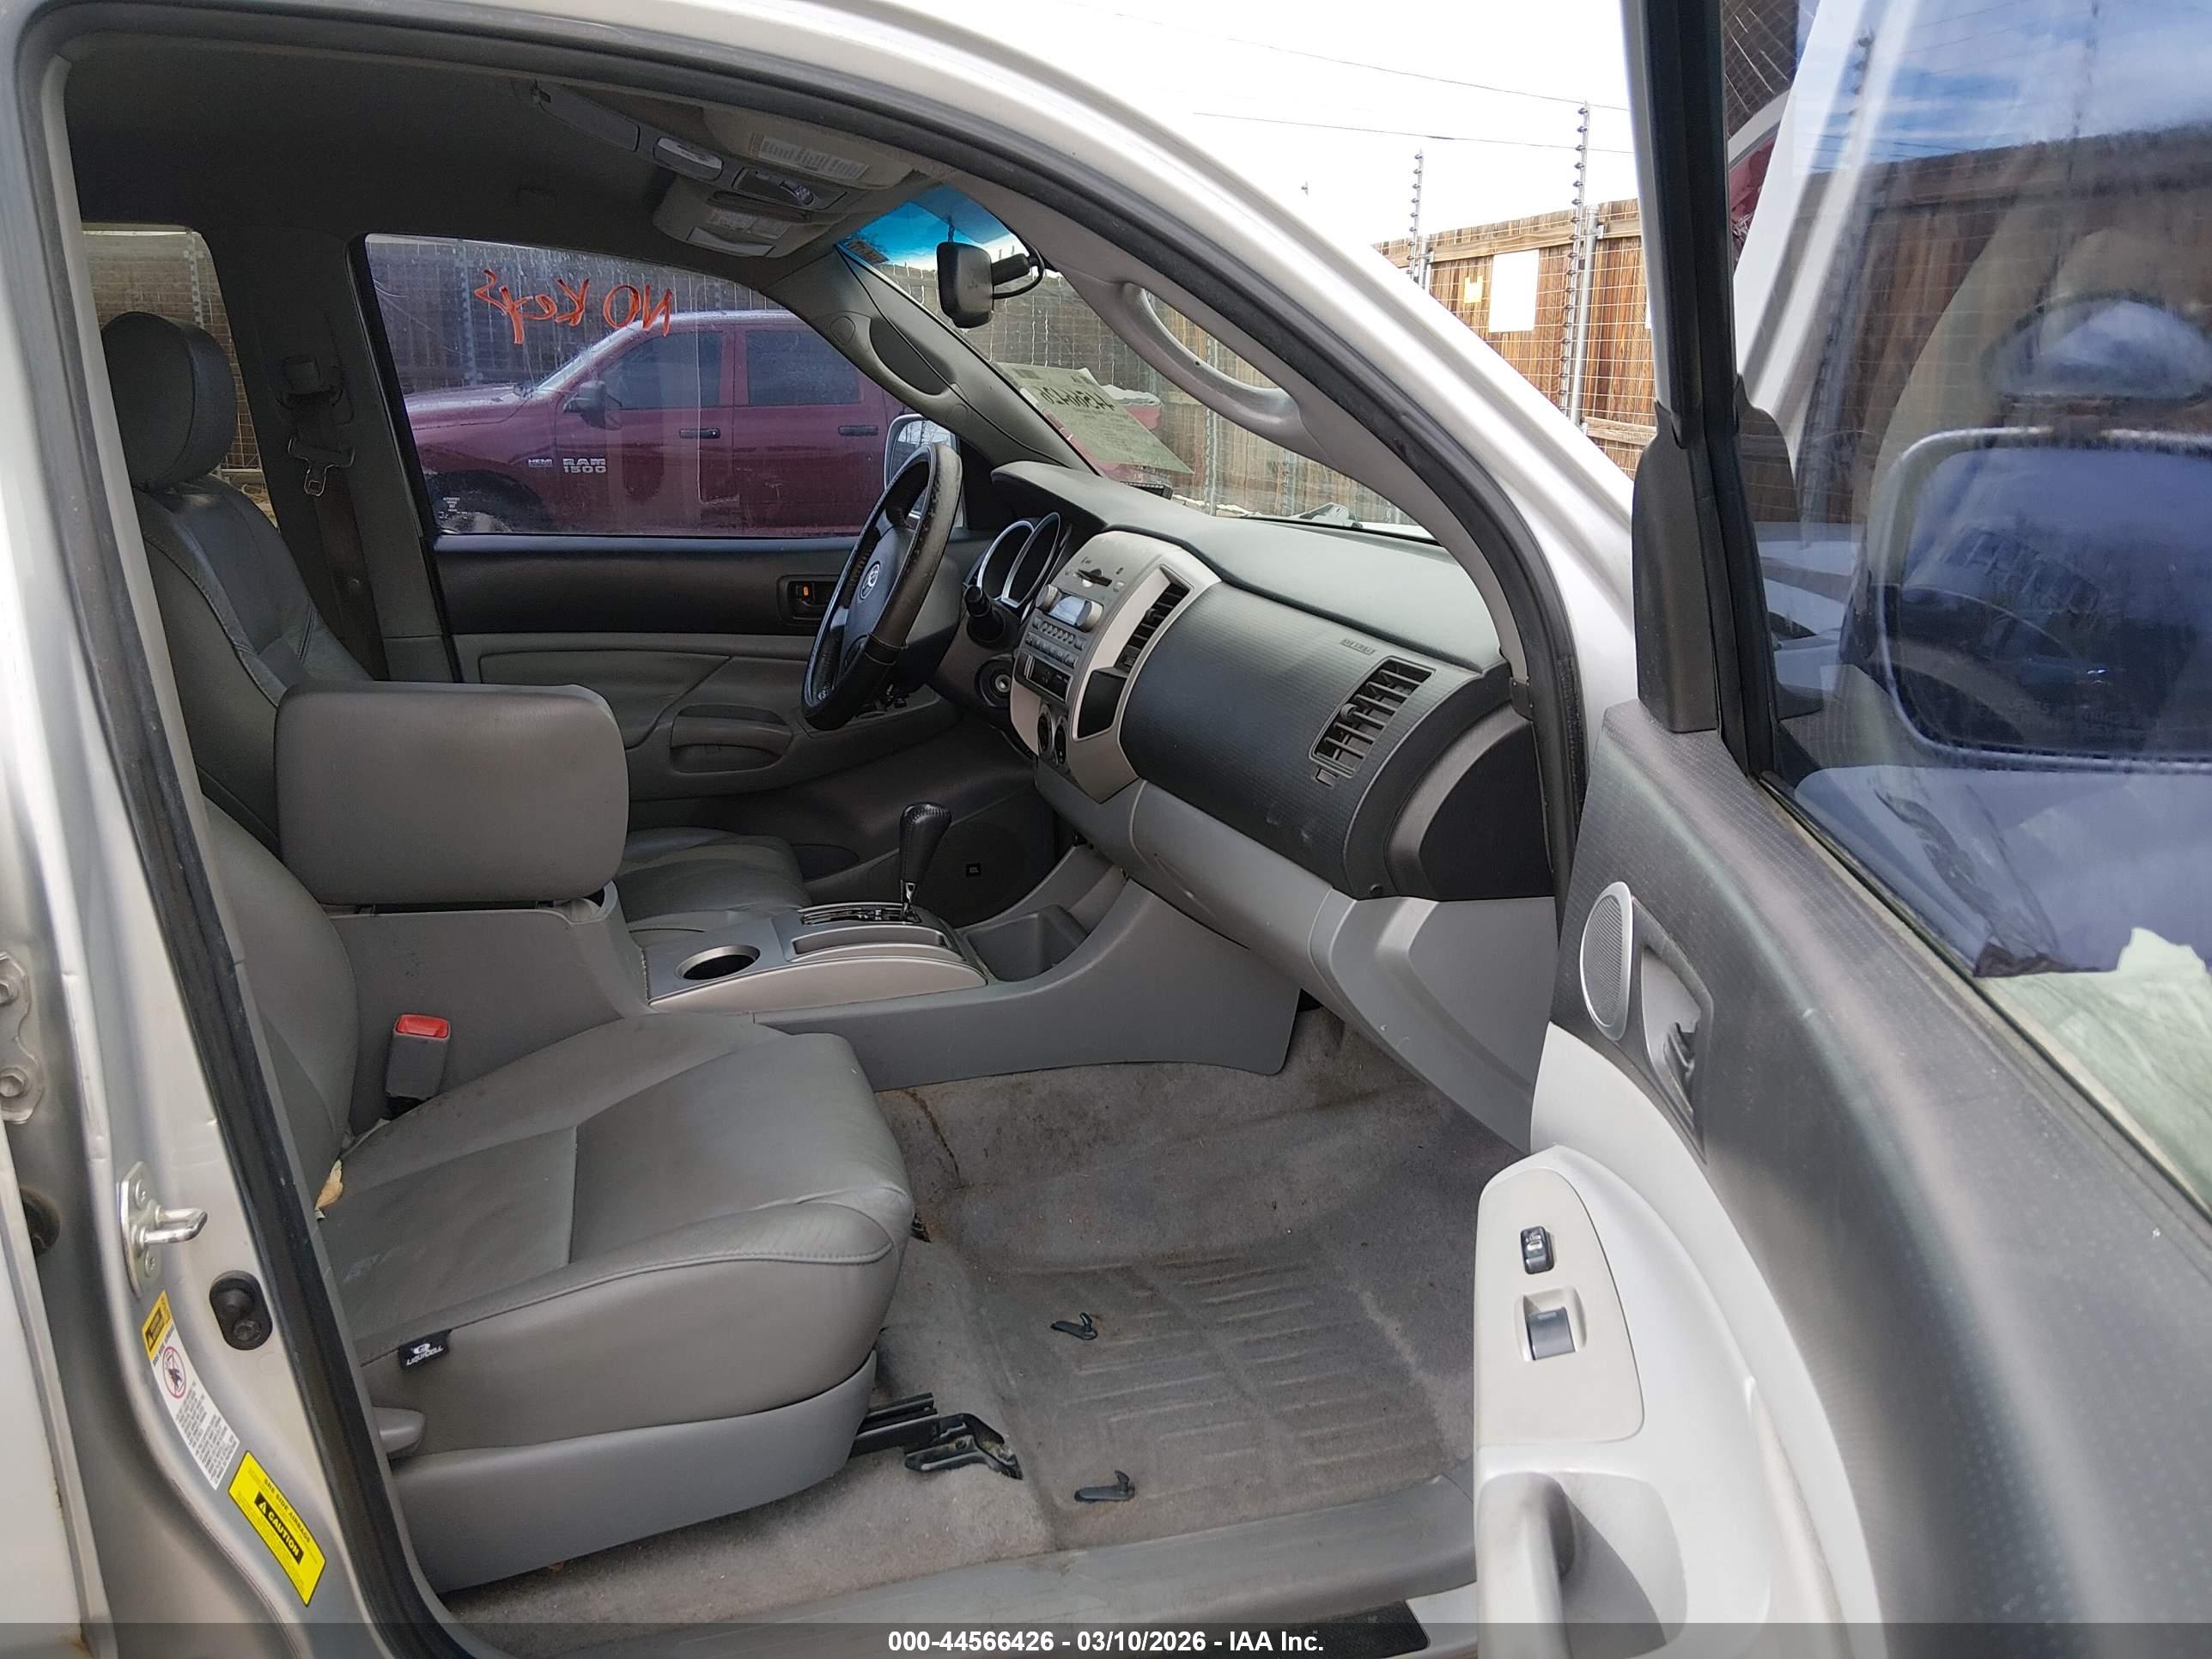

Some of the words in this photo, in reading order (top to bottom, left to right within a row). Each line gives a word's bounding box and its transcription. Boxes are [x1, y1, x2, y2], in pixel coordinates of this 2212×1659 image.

[562, 458, 606, 466] RAM
[562, 465, 607, 474] 1500
[276, 1492, 289, 1511] SIDE
[289, 1510, 311, 1544] AIRBAGS
[268, 1510, 301, 1558] CAUTION
